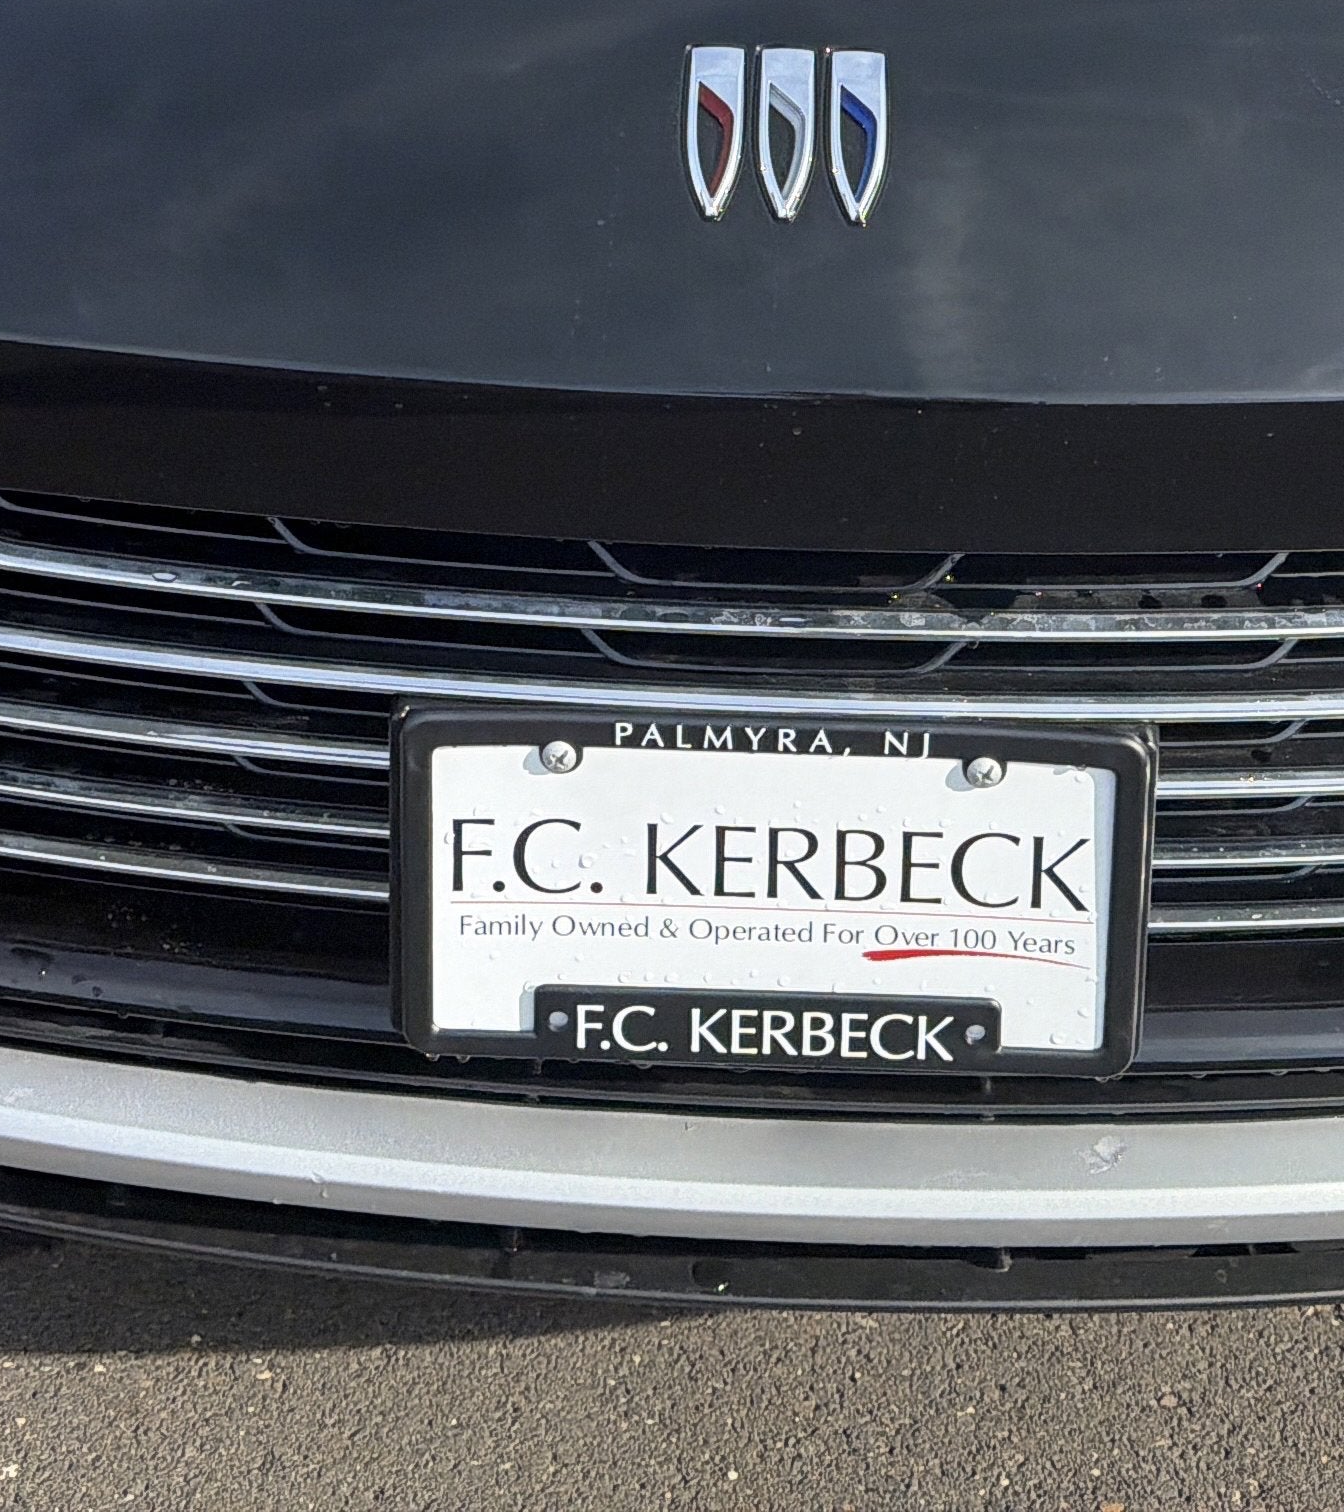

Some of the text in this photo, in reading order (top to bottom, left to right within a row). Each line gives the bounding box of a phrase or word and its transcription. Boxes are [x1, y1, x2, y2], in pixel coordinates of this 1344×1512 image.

[883, 730, 931, 759] NJ
[452, 818, 1091, 912] F.C. KERBECK
[460, 914, 1076, 955] Family Owned & Operated For Over 100 Years
[576, 1004, 954, 1061] F.C. KERBECK
